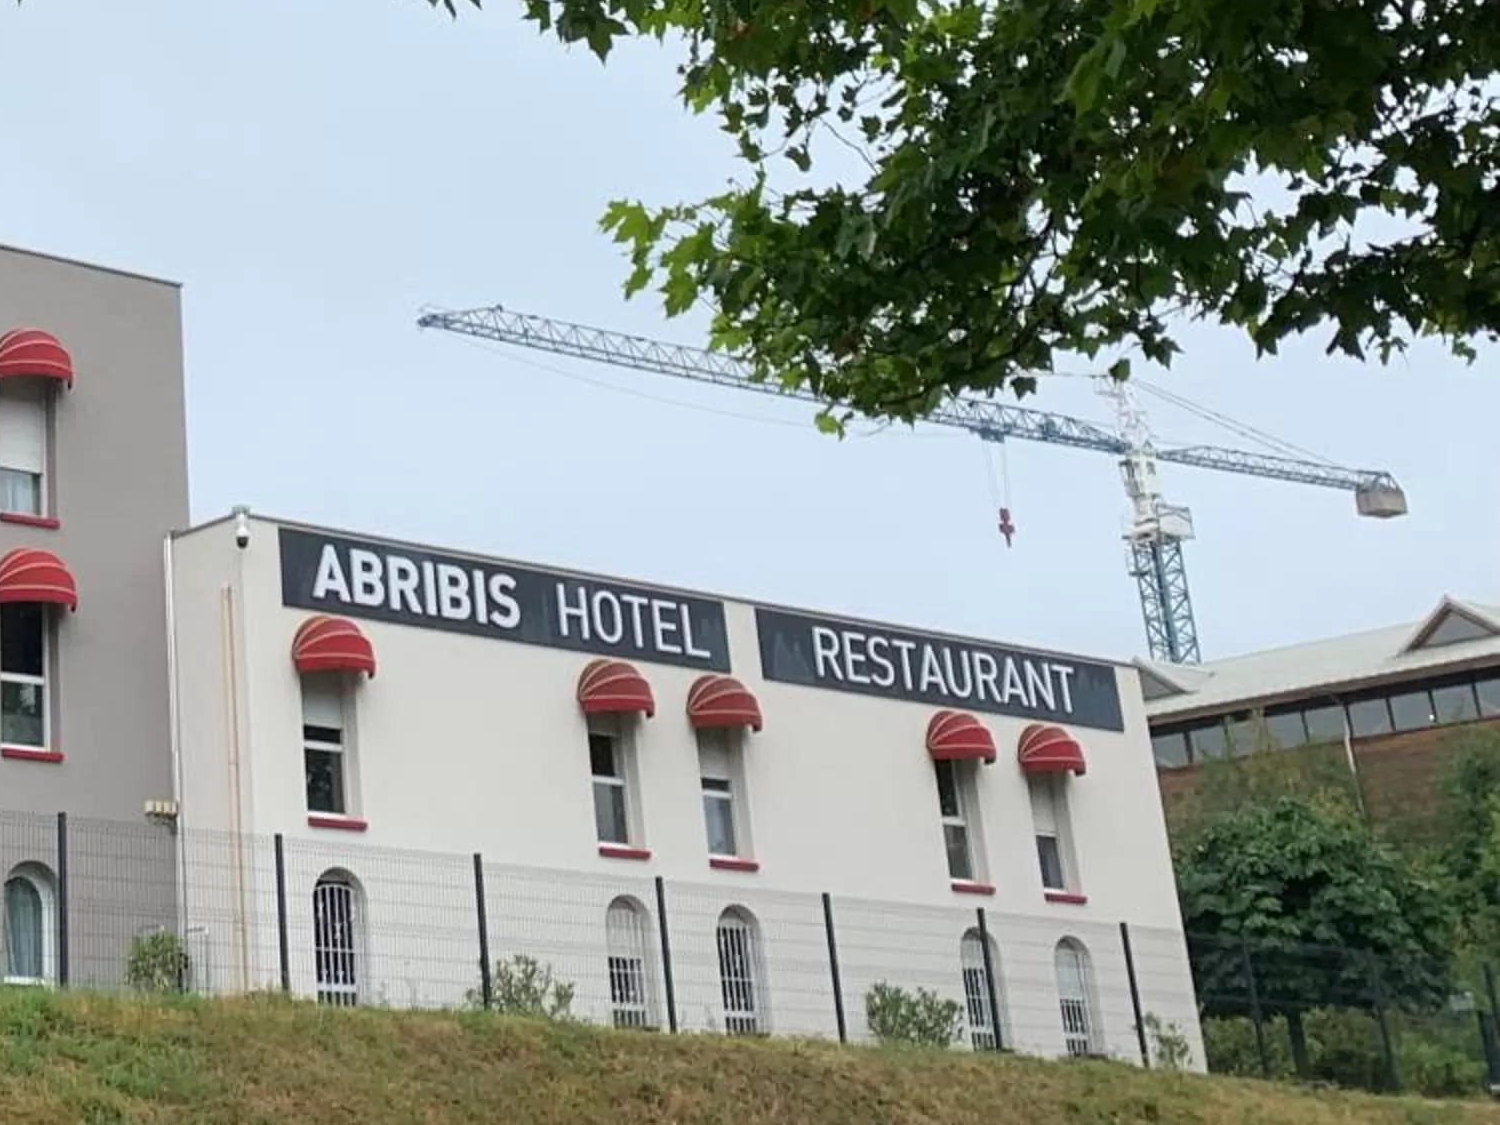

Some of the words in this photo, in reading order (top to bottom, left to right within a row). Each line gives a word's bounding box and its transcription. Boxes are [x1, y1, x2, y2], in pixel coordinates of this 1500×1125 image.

[313, 544, 521, 628] ABRIBIS
[555, 582, 711, 658] HOTEL
[811, 626, 1074, 713] RESTAURANT
